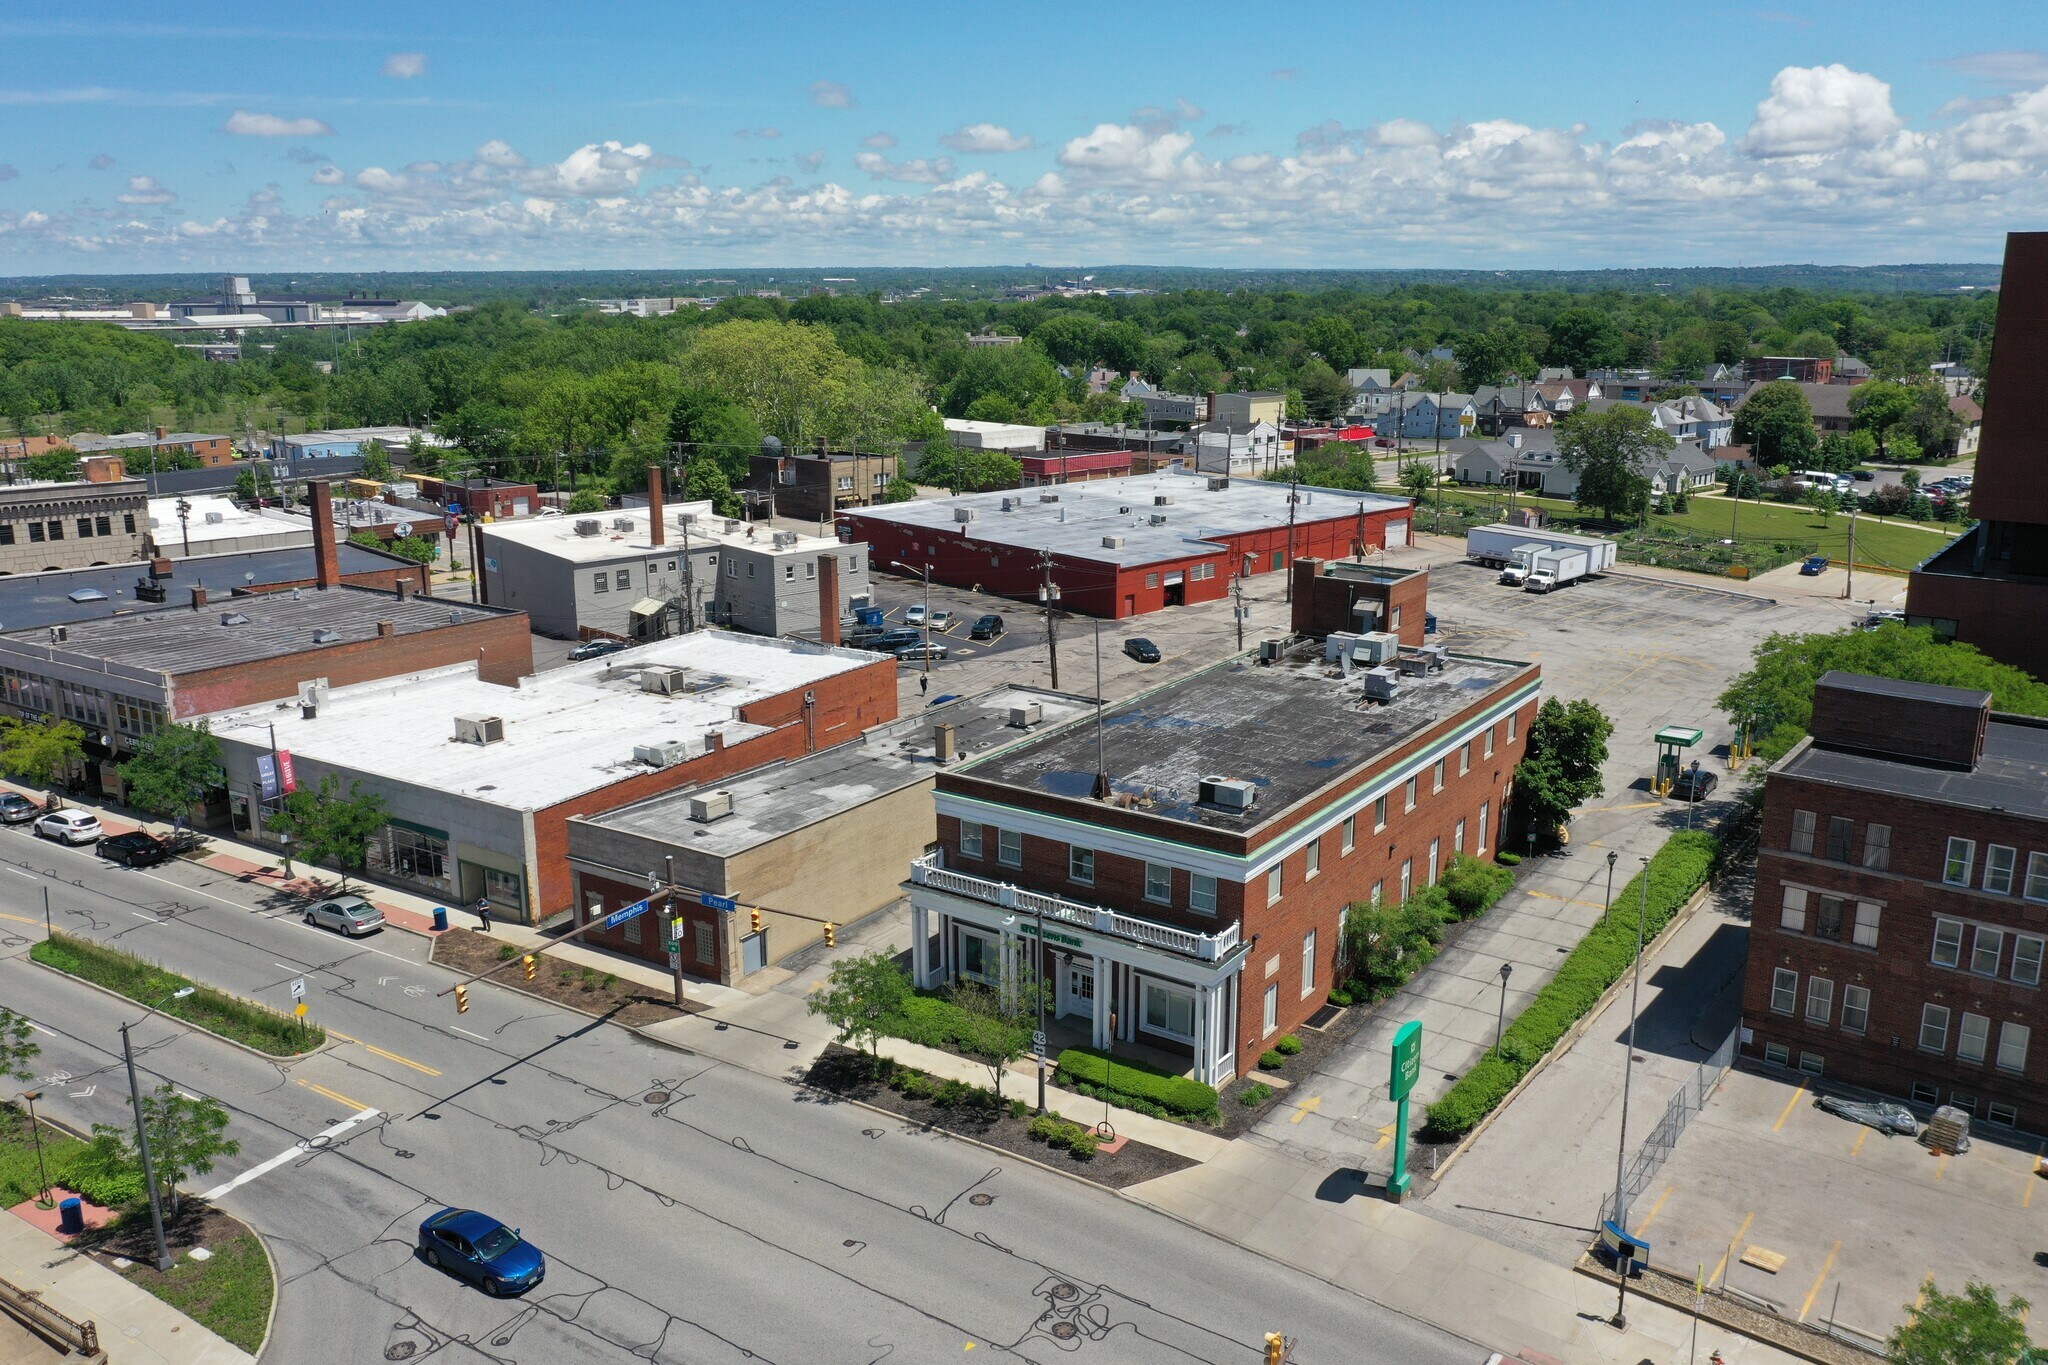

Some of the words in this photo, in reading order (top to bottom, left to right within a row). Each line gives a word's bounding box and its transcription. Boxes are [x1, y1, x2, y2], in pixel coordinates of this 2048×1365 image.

[708, 897, 728, 909] Pearl
[610, 903, 643, 924] Memphis
[1060, 934, 1083, 948] Bank
[1033, 1032, 1045, 1043] 42
[1405, 1063, 1417, 1081] Bank
